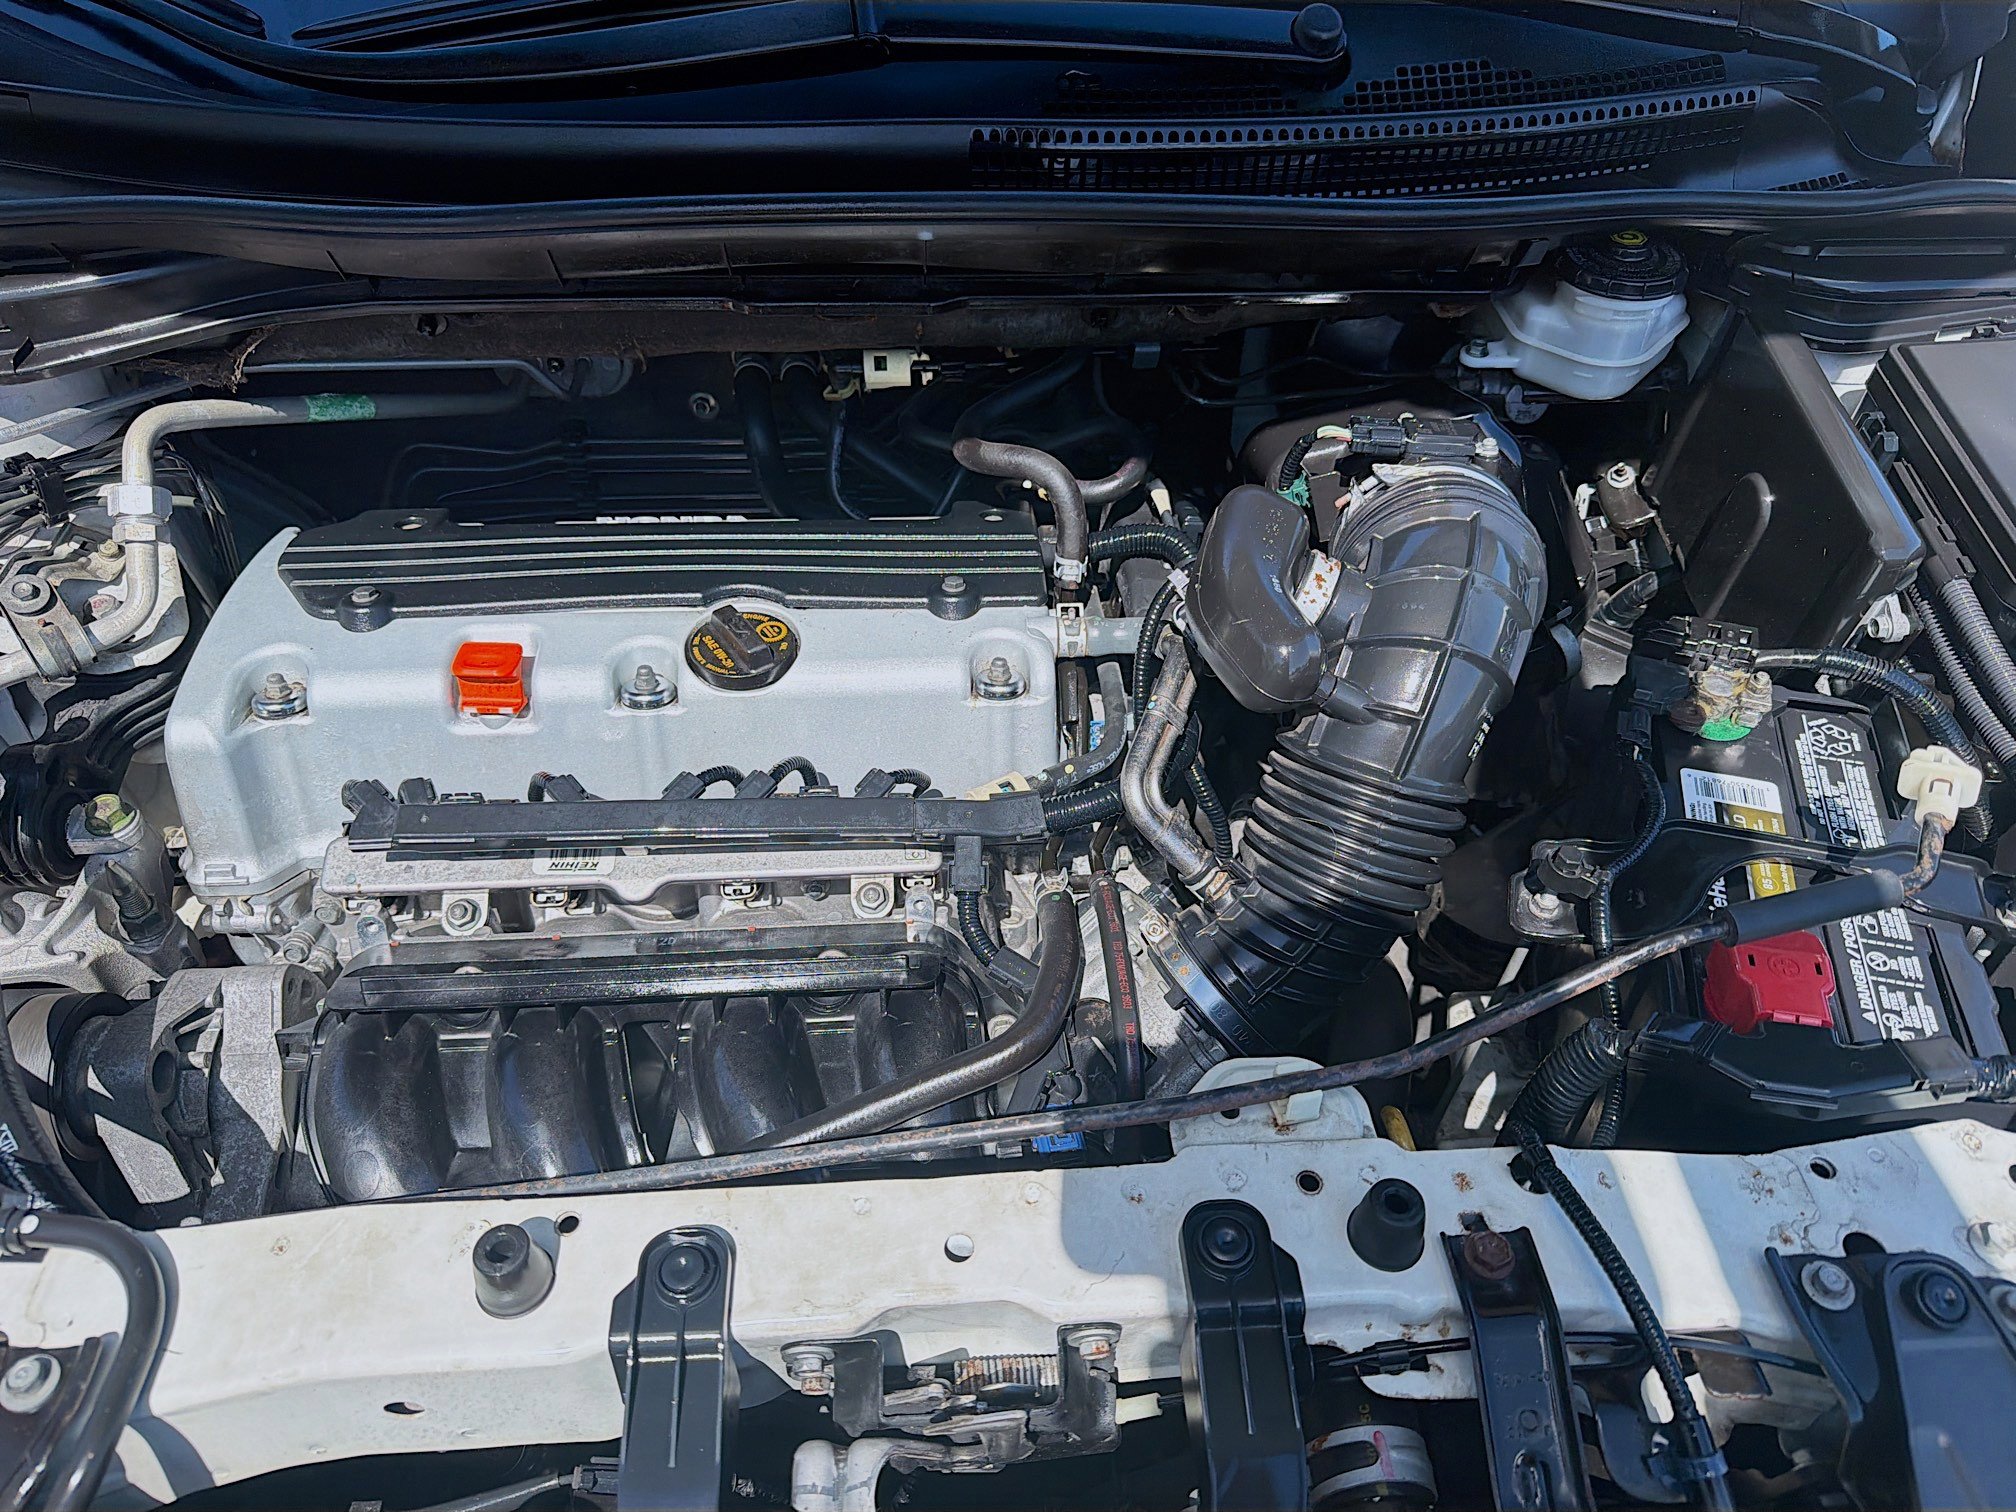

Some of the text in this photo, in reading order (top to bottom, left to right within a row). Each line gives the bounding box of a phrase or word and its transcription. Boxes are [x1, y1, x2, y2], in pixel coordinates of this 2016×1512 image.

[702, 635, 719, 650] SAE
[549, 862, 600, 873] KEIHIN
[1761, 877, 1774, 891] 85
